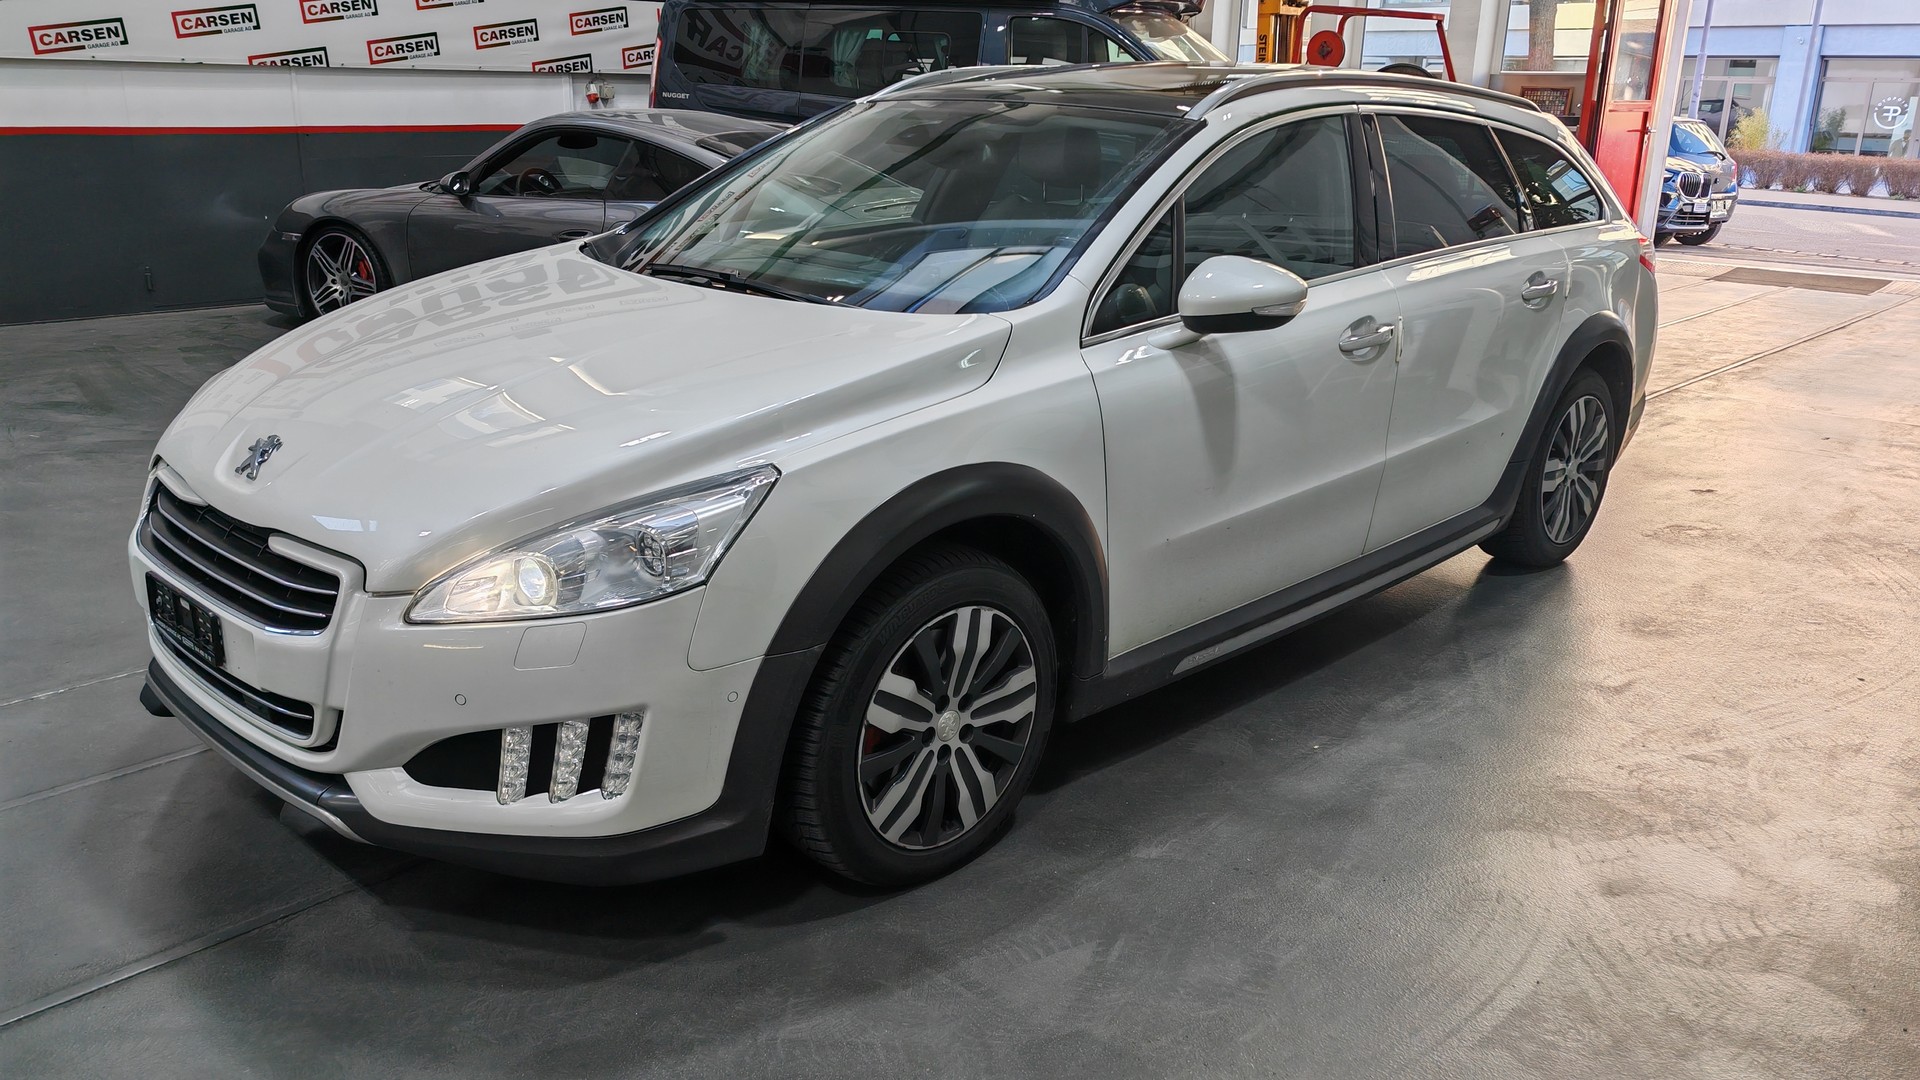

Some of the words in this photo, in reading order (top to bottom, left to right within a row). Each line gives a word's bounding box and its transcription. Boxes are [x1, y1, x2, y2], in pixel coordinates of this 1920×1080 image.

[307, 0, 372, 16] CARSEN
[181, 11, 253, 31] CARSEN
[575, 12, 624, 29] CARSEN
[39, 26, 120, 46] CARSEN
[479, 25, 534, 42] CARSEN
[87, 42, 110, 50] GARAGE
[374, 39, 435, 57] CARSEN
[662, 91, 690, 99] NUGGET
